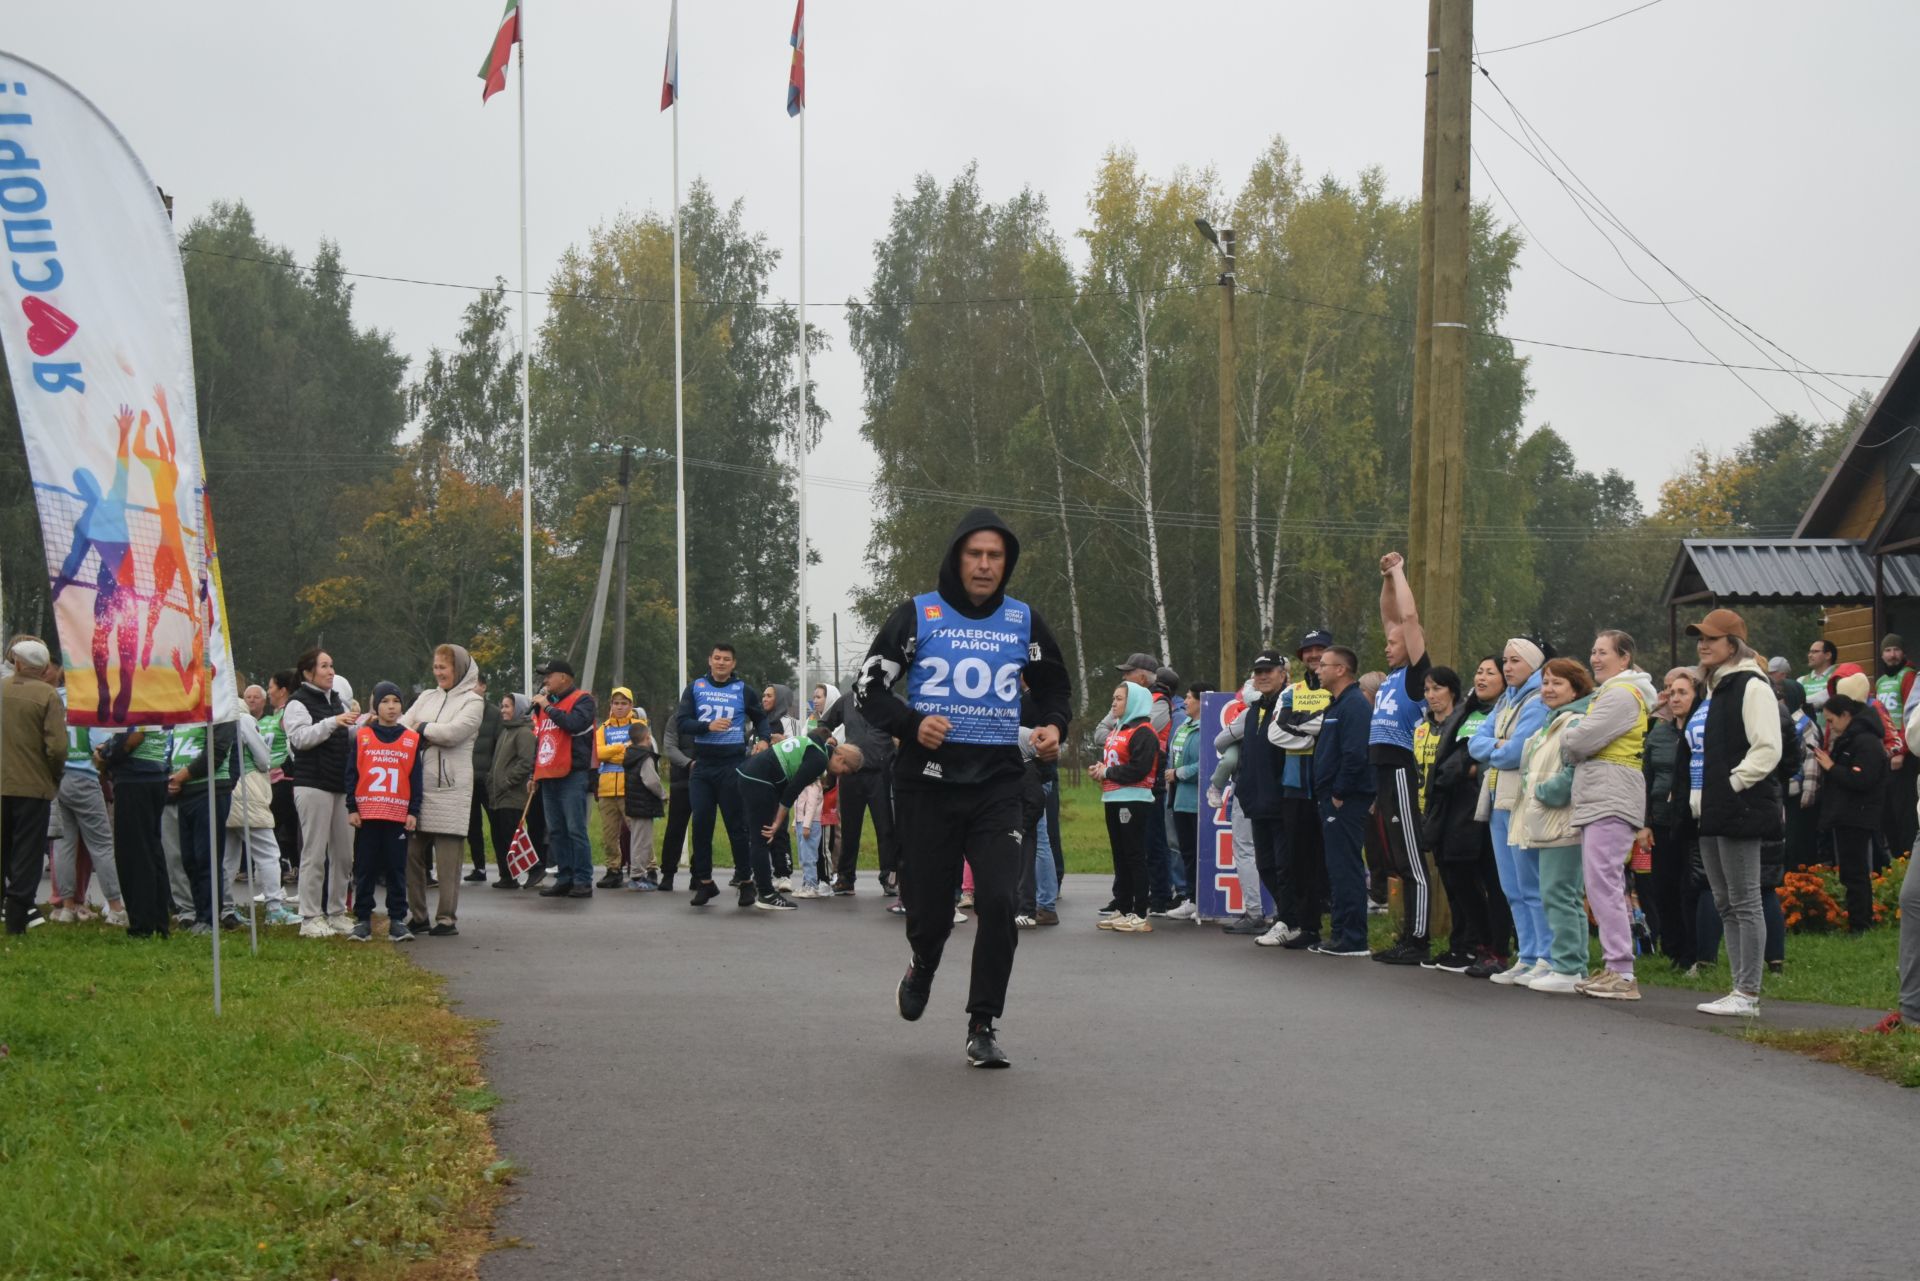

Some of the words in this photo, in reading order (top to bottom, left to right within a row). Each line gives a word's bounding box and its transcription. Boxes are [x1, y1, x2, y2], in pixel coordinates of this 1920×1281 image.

[32, 362, 86, 395] Я
[951, 639, 1000, 652] РАЙОН
[919, 656, 1021, 702] 206
[698, 704, 735, 723] 211
[368, 766, 399, 794] 21
